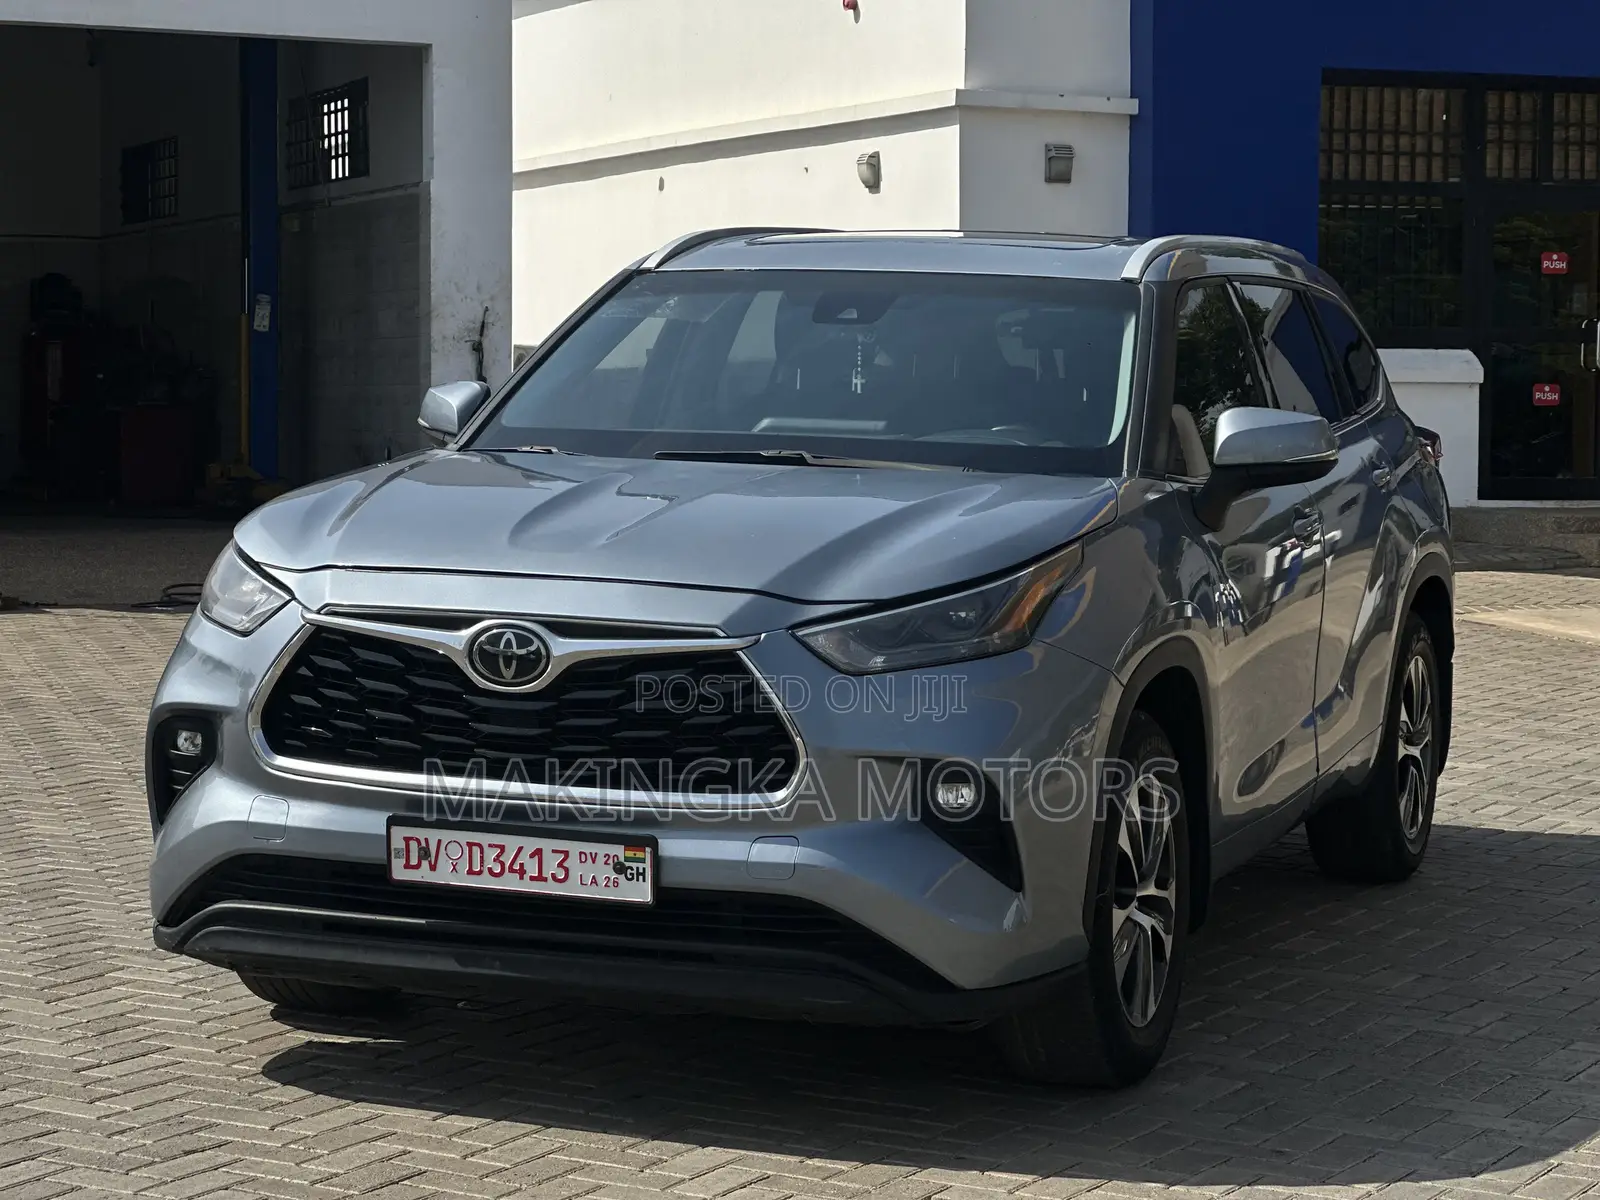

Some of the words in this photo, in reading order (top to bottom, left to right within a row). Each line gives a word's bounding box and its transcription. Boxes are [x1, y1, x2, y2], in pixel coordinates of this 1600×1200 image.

[1543, 260, 1567, 269] PUSH
[1535, 391, 1559, 400] PUSH
[402, 836, 442, 872] DV
[465, 841, 570, 884] D3413
[578, 851, 599, 864] DV
[578, 873, 599, 887] LA
[603, 875, 621, 888] 26
[624, 865, 647, 883] GH
